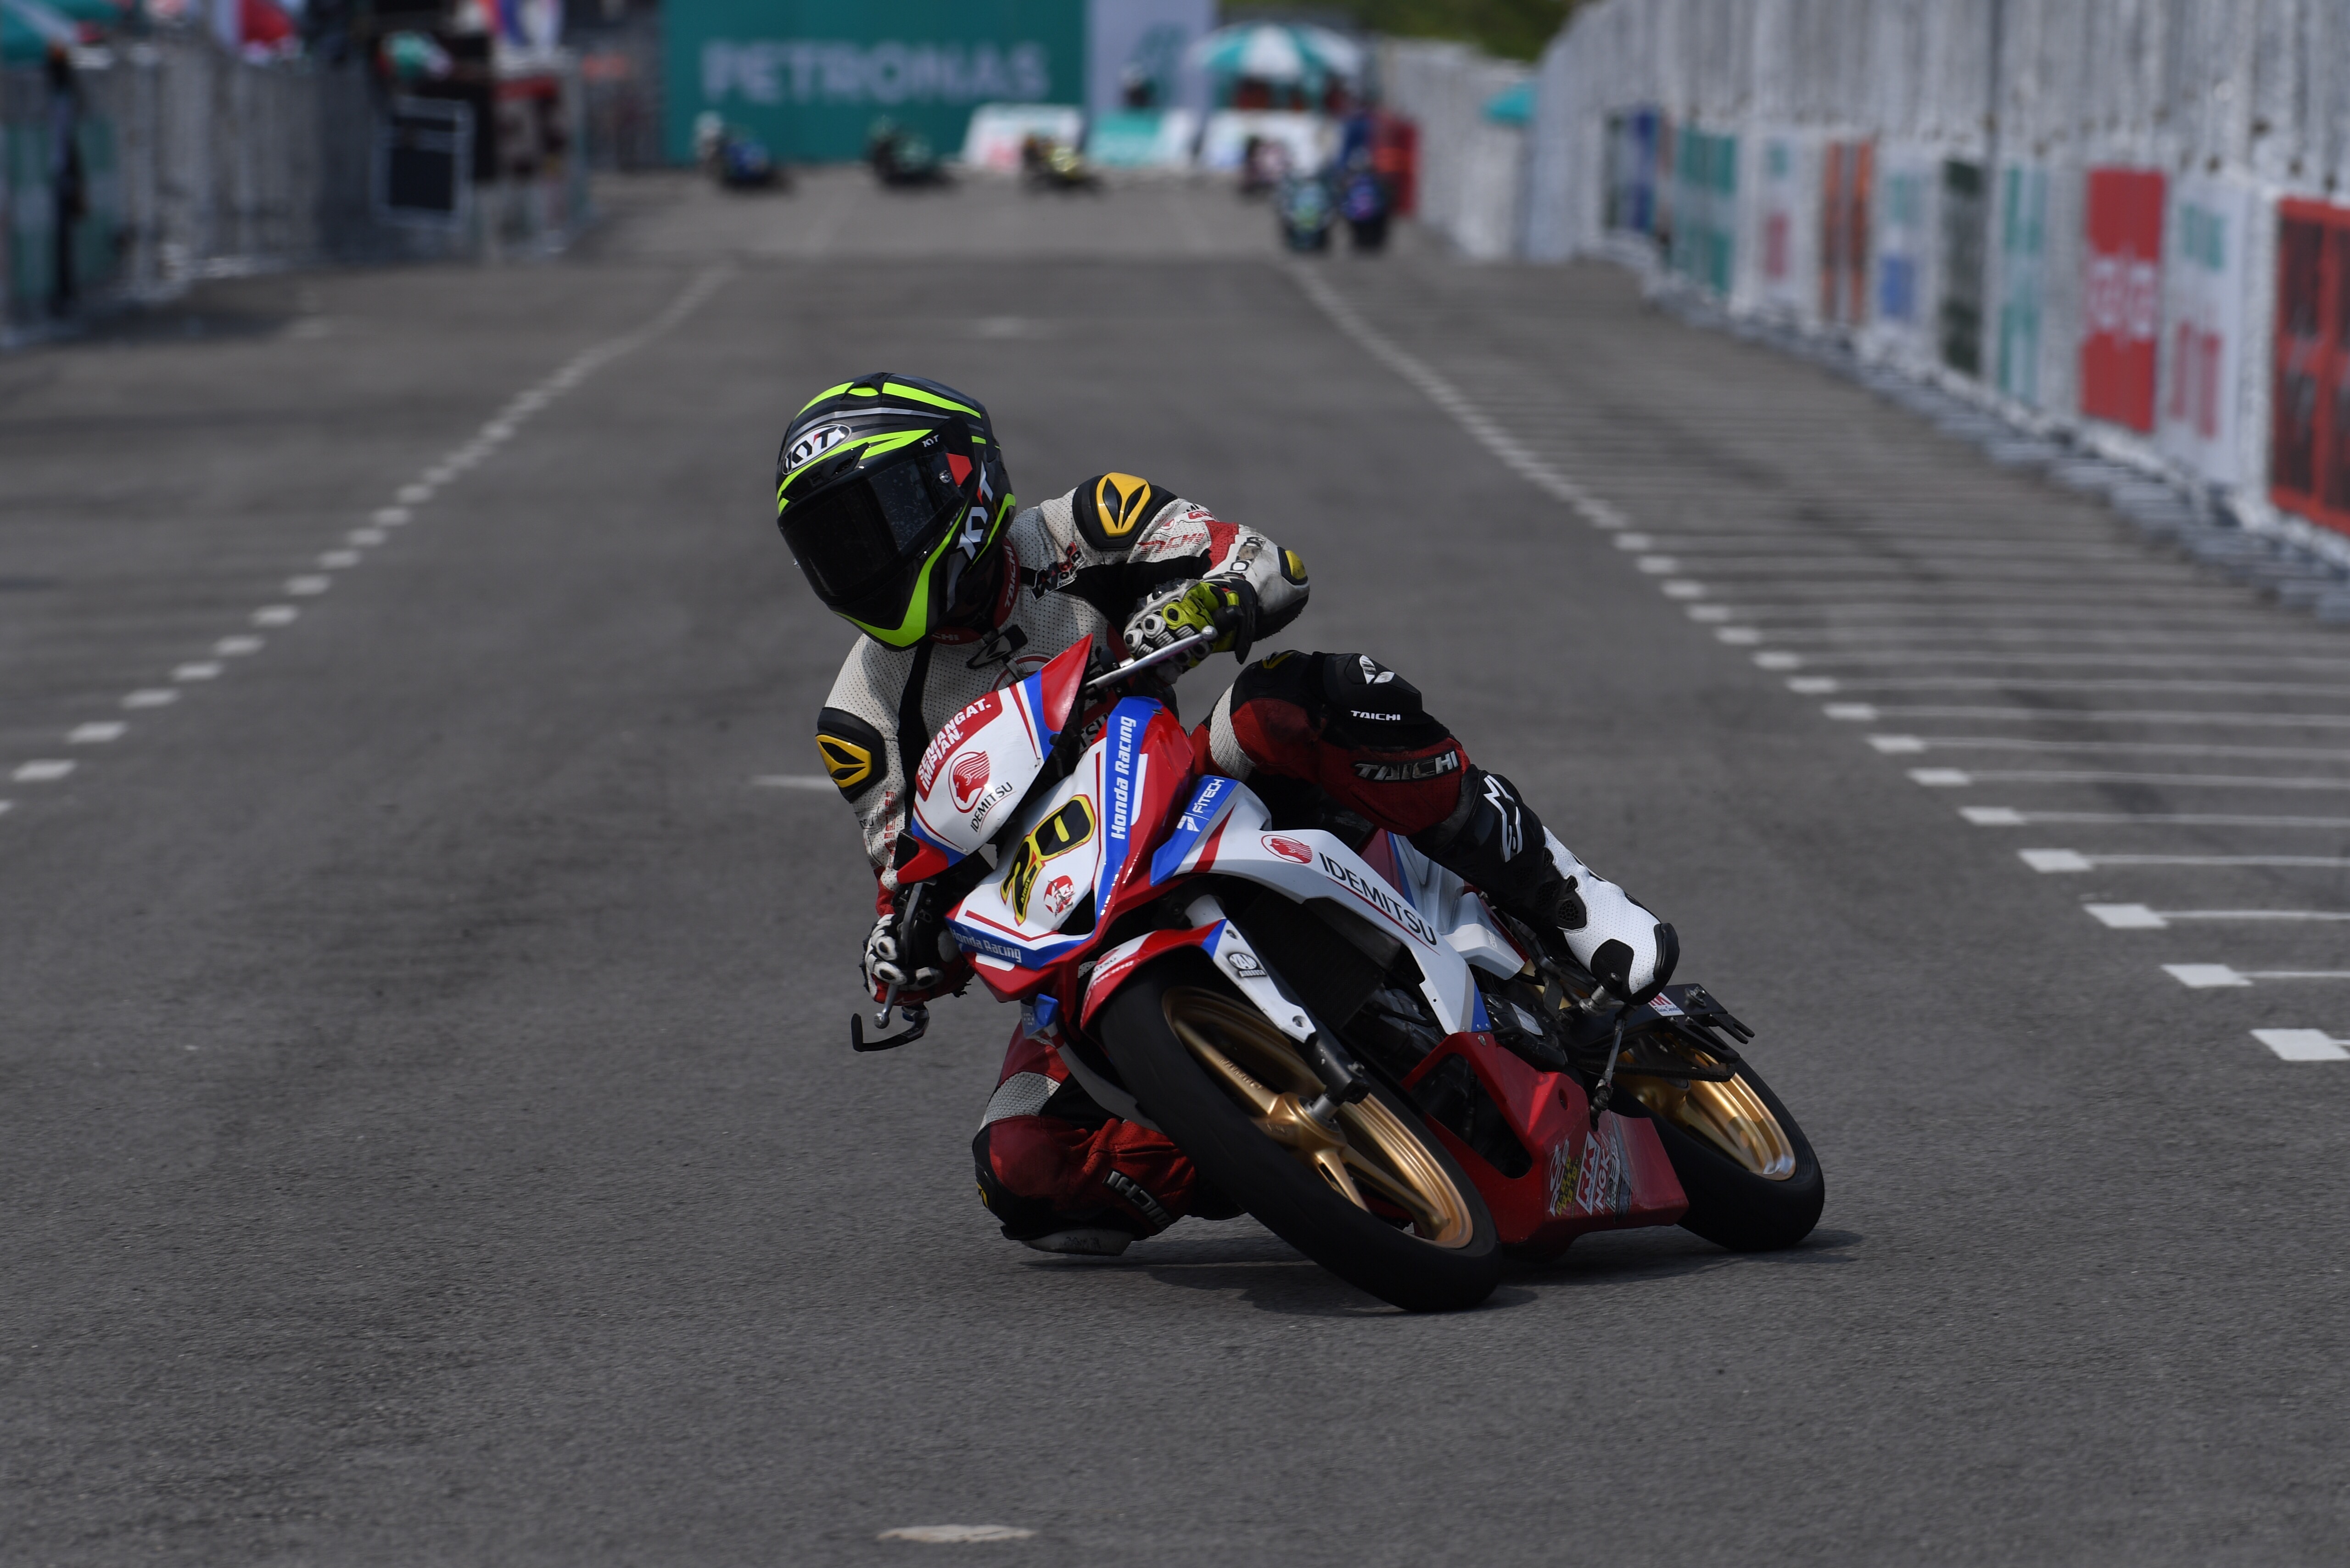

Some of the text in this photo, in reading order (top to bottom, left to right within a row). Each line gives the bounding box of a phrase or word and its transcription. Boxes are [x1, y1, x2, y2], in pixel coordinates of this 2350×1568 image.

[703, 42, 1047, 99] PETRONAS
[786, 426, 840, 472] KYT
[922, 435, 939, 448] KYT
[956, 460, 993, 560] KYT
[1004, 546, 1015, 607] TAICHI
[918, 699, 991, 777] SEMANGAT.
[1350, 710, 1401, 721] TAICHI
[922, 729, 963, 791] IMPIAN.
[1111, 716, 1136, 839] Honda Racing
[1354, 750, 1459, 780] TAICHI
[970, 782, 1013, 832] IDEMITSU
[1002, 798, 1093, 920] 20
[1020, 877, 1031, 903] AZROY
[1319, 852, 1438, 946] IDEMITSU
[949, 927, 1022, 963] Honda Racing
[1578, 1137, 1596, 1206] RK
[1595, 1148, 1610, 1210] NGK
